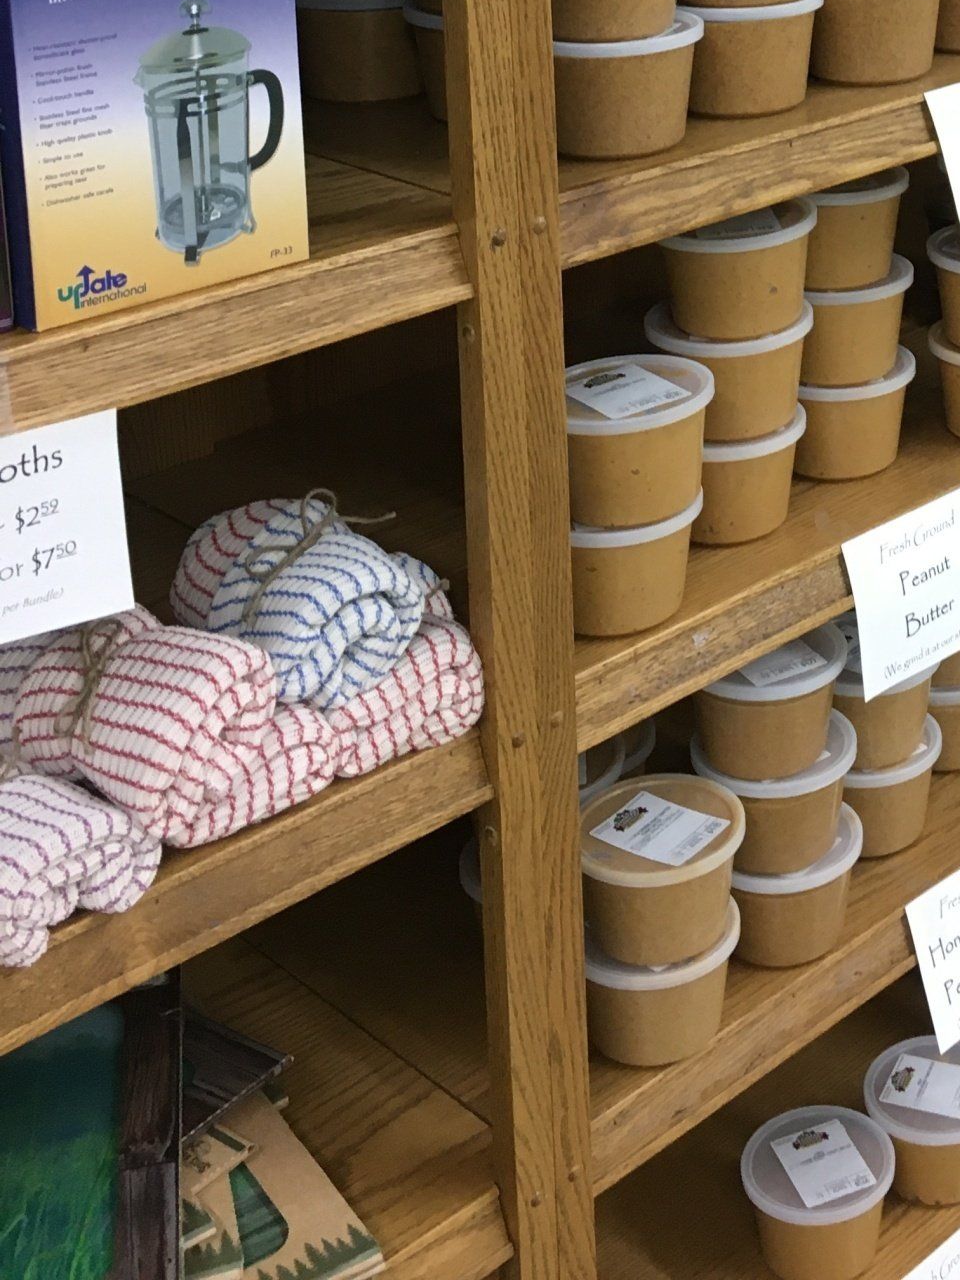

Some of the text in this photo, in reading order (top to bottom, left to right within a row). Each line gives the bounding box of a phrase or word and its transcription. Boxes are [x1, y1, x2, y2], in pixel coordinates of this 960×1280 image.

[80, 282, 147, 308] international
[0, 444, 63, 483] oths
[879, 509, 956, 564] Fresh Ground
[899, 555, 950, 596] Peanut
[905, 598, 955, 638] Butter
